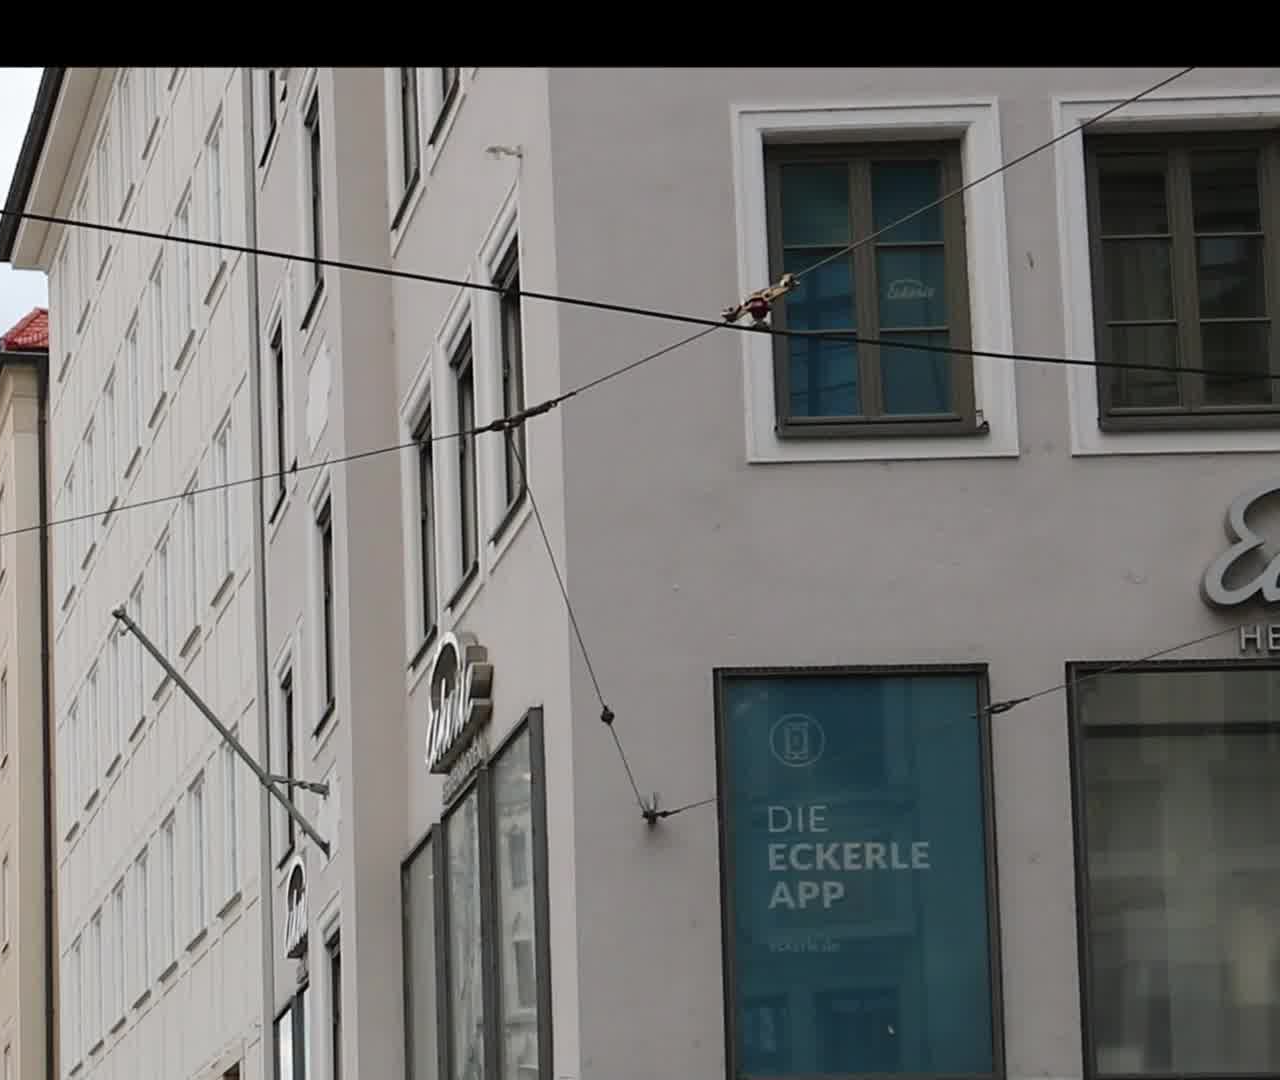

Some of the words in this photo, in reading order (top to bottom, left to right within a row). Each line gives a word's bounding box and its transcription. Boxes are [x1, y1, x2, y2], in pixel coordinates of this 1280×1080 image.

[767, 805, 829, 833] DIE
[768, 841, 931, 871] ECKERLE
[768, 881, 845, 909] APP
